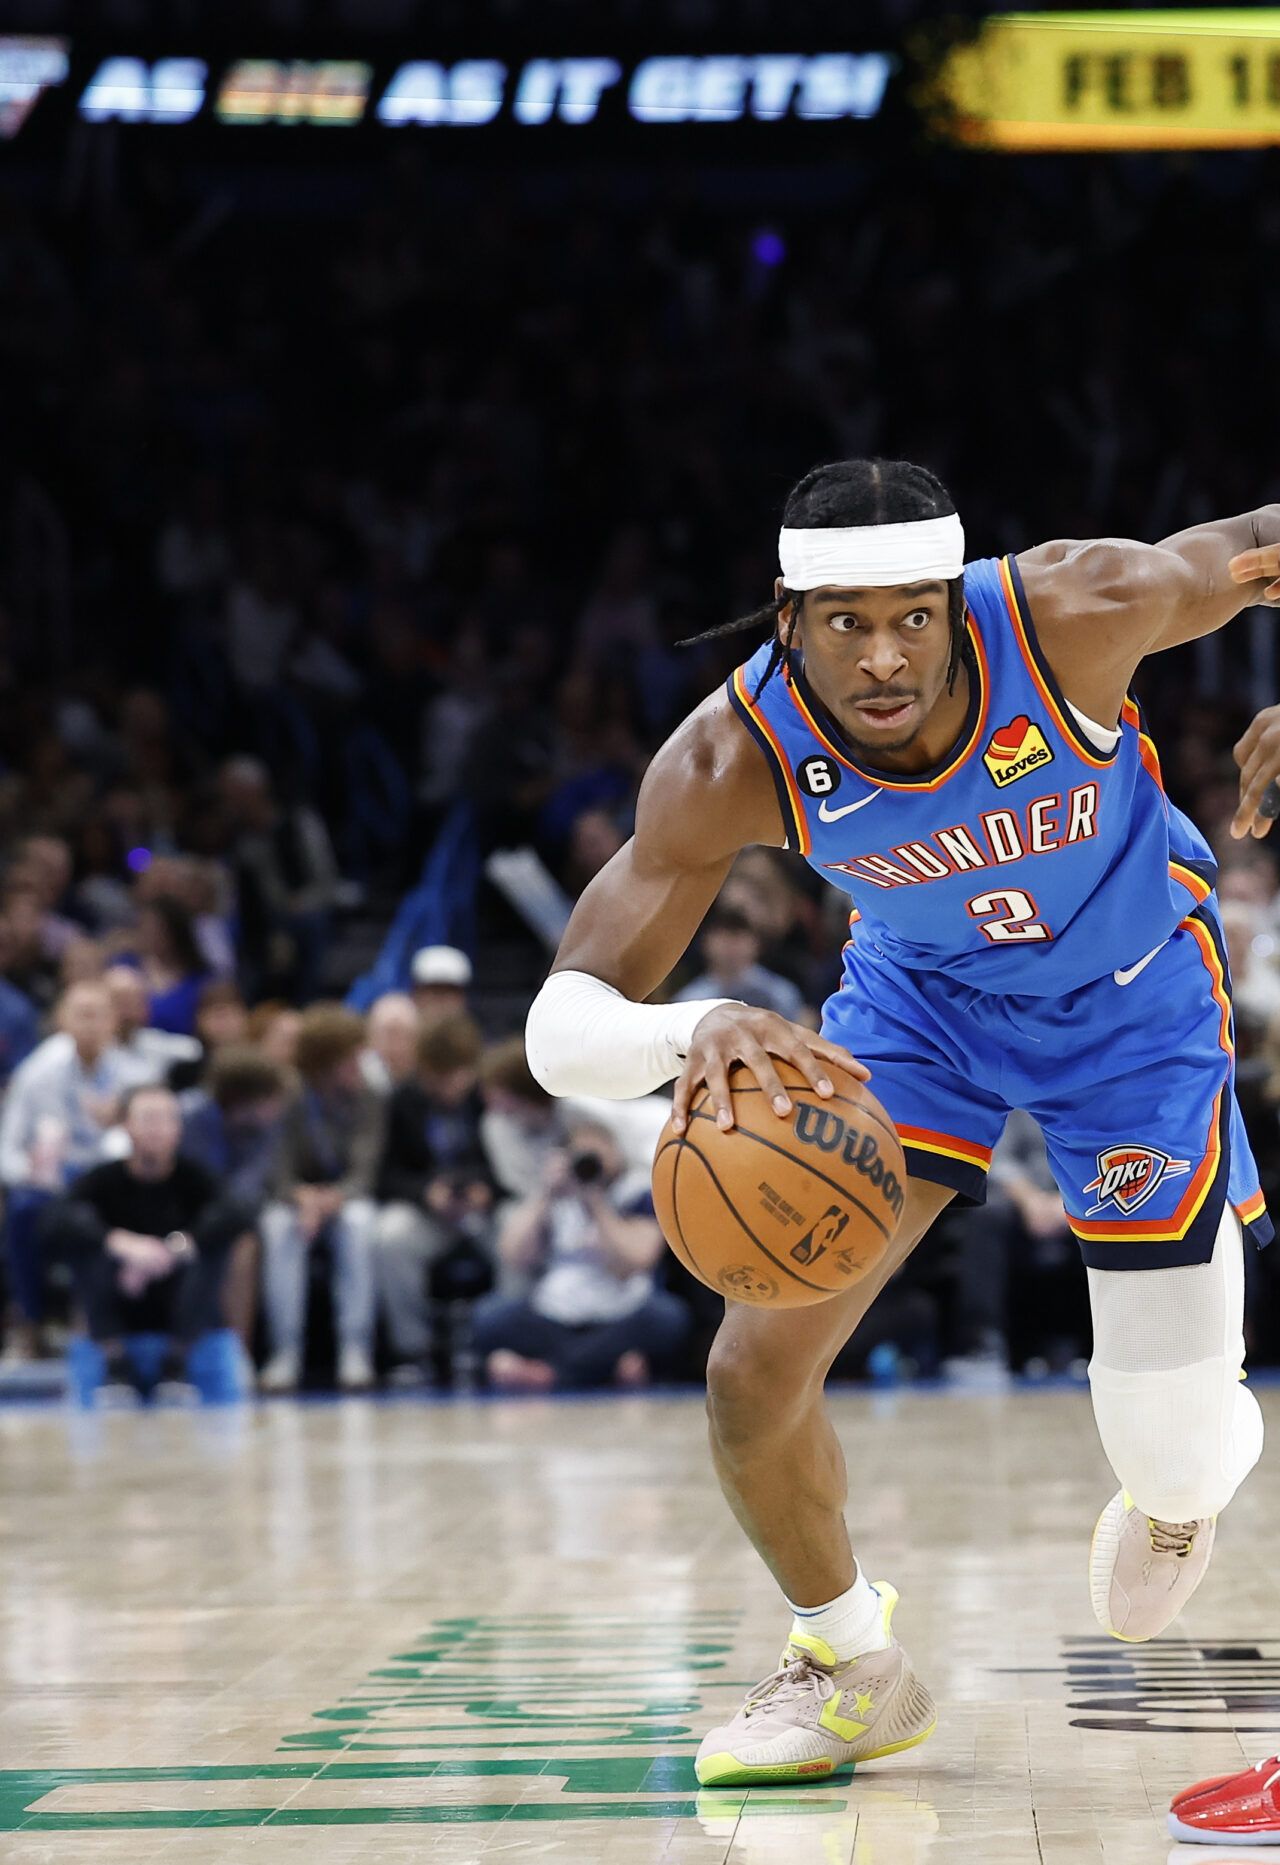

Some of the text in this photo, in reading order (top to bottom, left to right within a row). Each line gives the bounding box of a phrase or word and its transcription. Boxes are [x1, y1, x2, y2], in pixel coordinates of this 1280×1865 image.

[804, 760, 833, 794] 6
[820, 781, 1100, 890] THUNDER
[964, 887, 1056, 943] 2
[793, 1100, 906, 1222] Wilson
[1099, 1158, 1152, 1200] OKC
